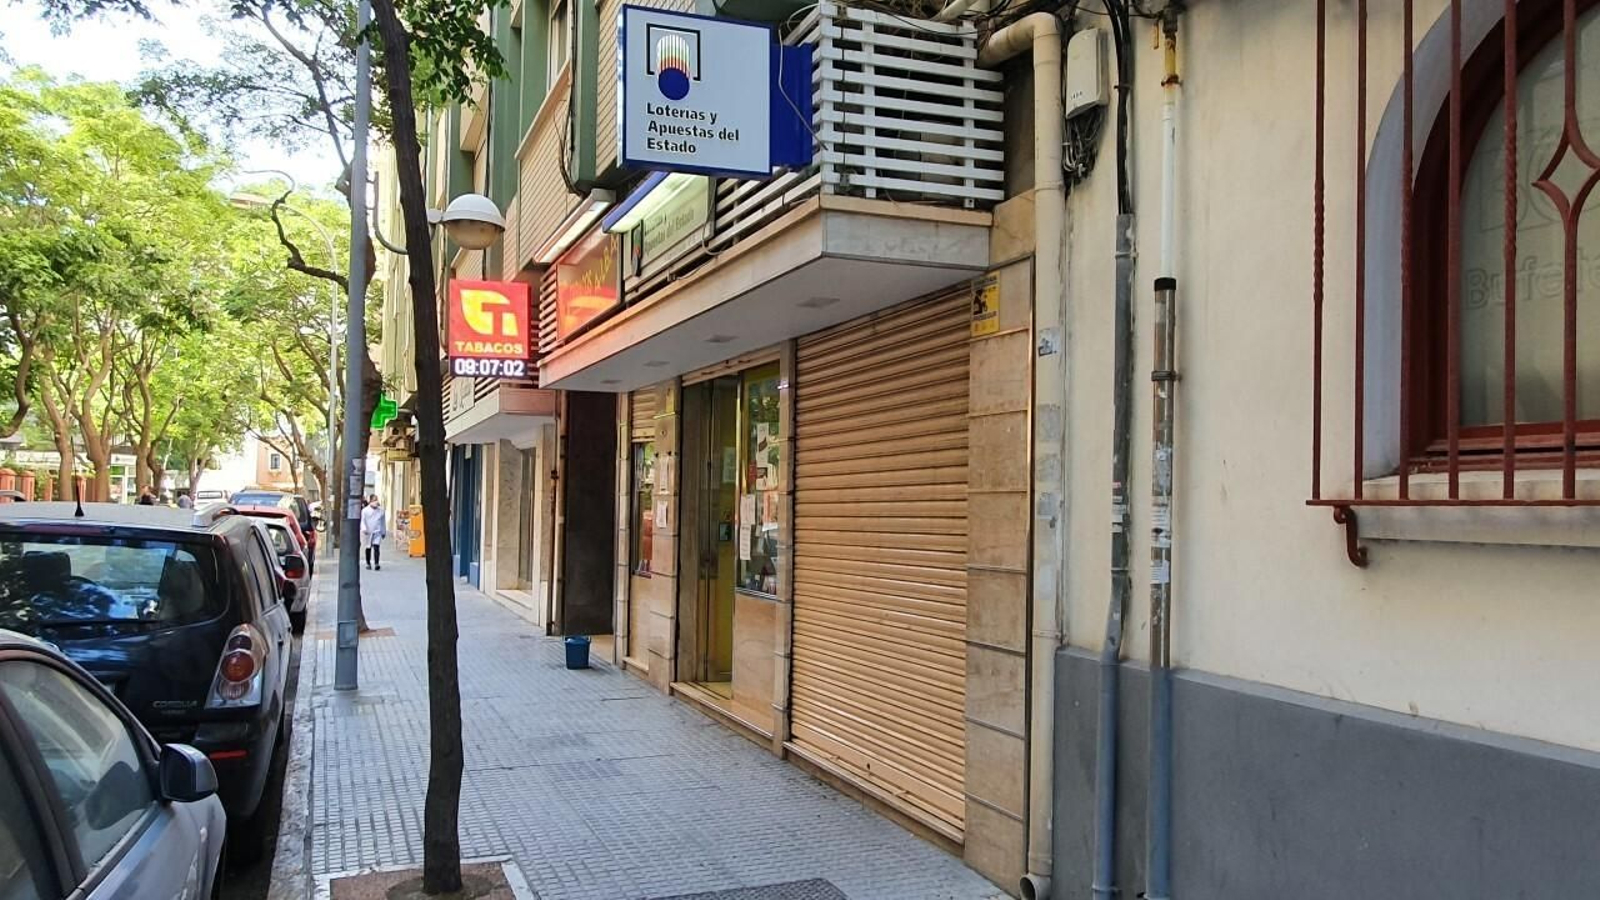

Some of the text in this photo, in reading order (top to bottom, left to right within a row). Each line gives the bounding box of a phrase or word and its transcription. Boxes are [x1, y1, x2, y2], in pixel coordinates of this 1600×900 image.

[709, 112, 718, 125] y
[648, 120, 739, 141] Apuestas del
[646, 137, 697, 153] Estado
[455, 341, 523, 354] TABACOS
